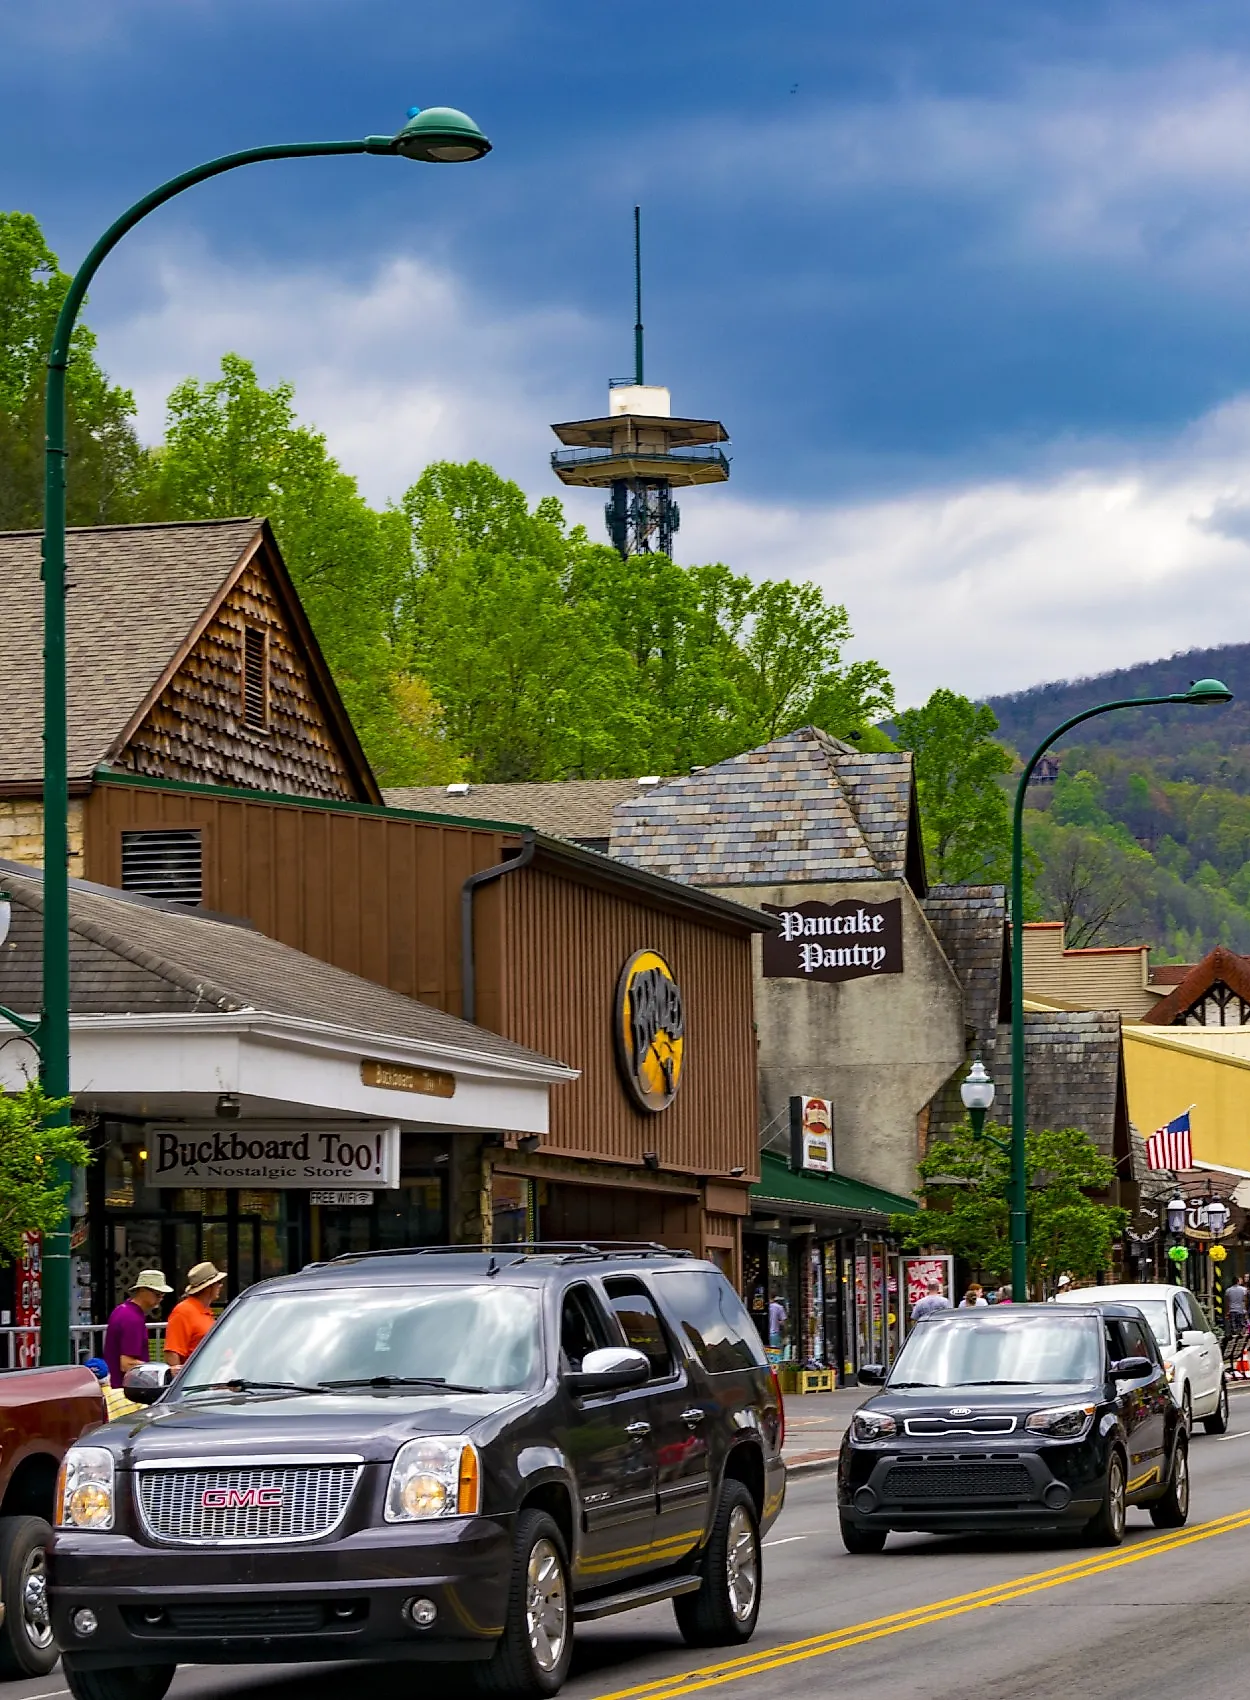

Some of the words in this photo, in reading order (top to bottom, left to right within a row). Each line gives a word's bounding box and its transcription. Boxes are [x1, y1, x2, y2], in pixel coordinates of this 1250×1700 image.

[778, 908, 885, 941] Pancake
[797, 943, 886, 972] Pantry
[156, 1132, 310, 1173] Buckboard
[319, 1133, 382, 1175] Too!
[184, 1166, 201, 1176] A
[207, 1166, 297, 1179] Nostalgic
[303, 1166, 353, 1177] Store
[310, 1191, 335, 1203] FREE
[202, 1487, 284, 1508] GMC
